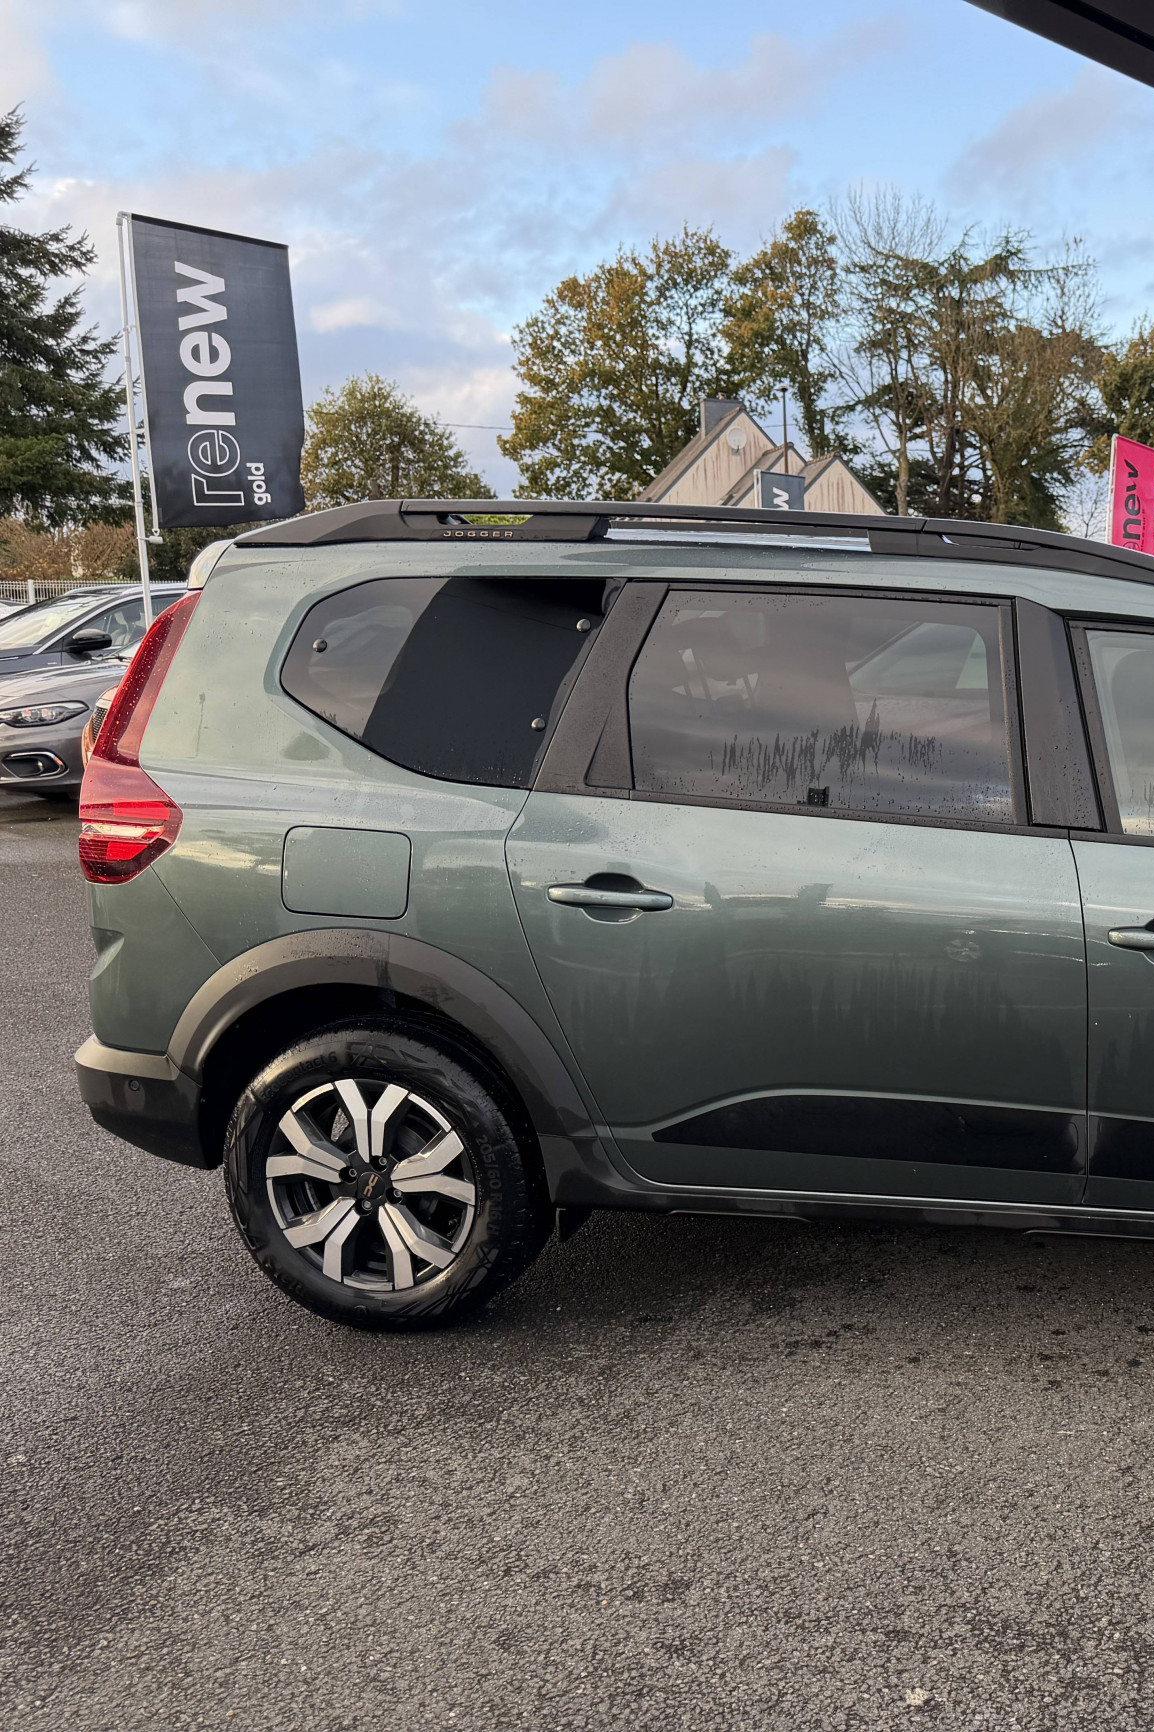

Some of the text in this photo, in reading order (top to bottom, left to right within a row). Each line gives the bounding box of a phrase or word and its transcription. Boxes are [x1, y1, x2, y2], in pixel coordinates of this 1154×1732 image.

[174, 260, 245, 507] renew
[247, 462, 272, 506] gold
[1122, 459, 1142, 550] new
[476, 1133, 502, 1190] 205/60
